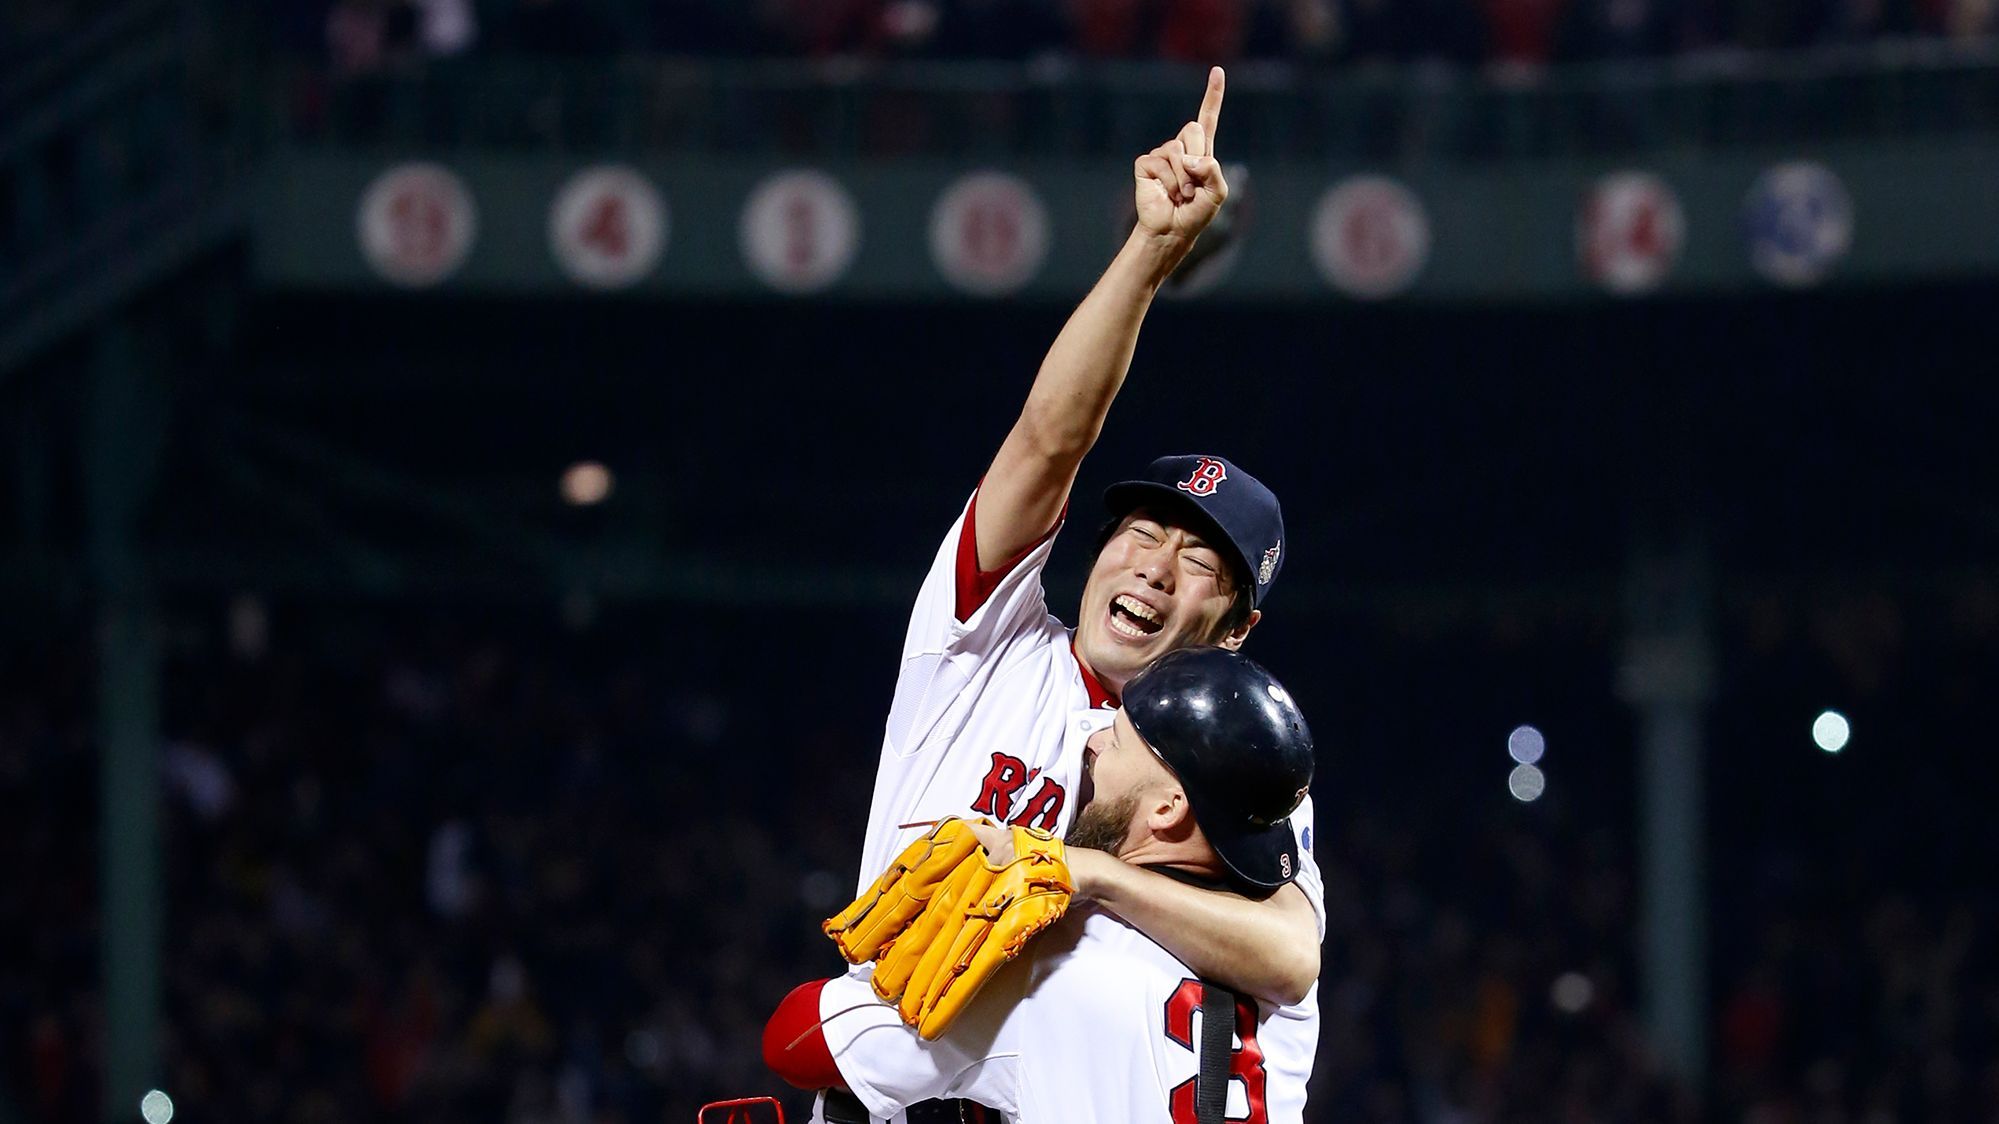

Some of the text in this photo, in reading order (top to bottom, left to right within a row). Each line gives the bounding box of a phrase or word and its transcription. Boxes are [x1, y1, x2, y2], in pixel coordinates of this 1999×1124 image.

[579, 190, 631, 261] 4
[1178, 458, 1227, 496] B
[970, 752, 1065, 833] RD
[1280, 853, 1292, 879] 3
